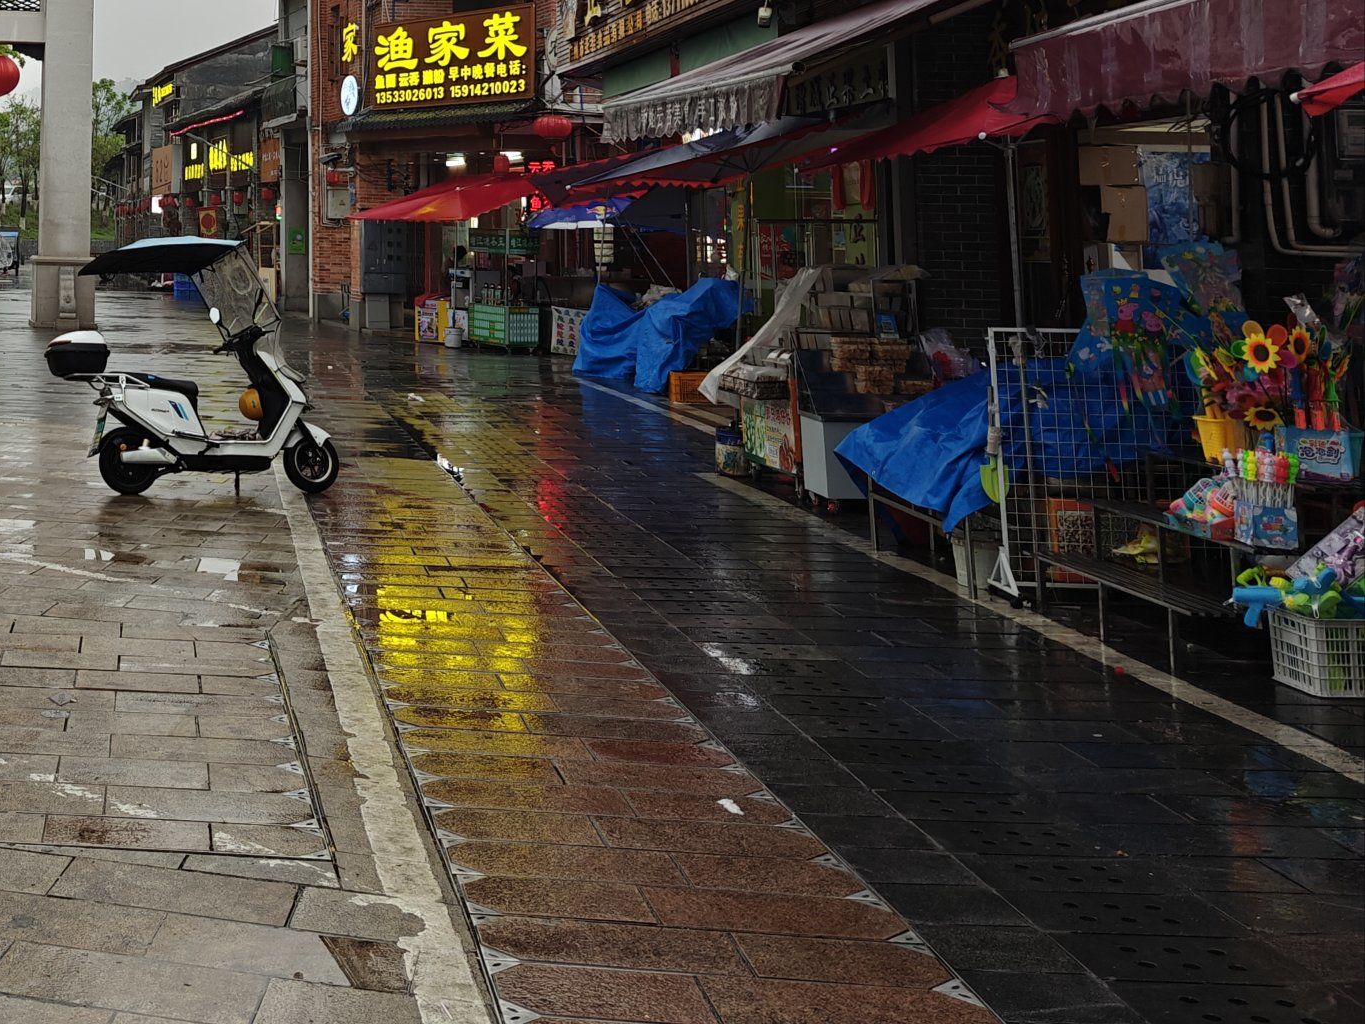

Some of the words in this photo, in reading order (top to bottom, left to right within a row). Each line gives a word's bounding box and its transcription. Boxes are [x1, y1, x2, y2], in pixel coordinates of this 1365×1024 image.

[374, 11, 528, 71] 渔家菜
[375, 87, 445, 104] 13533026013
[449, 79, 526, 98] 15914210023
[398, 71, 420, 87] 云吞
